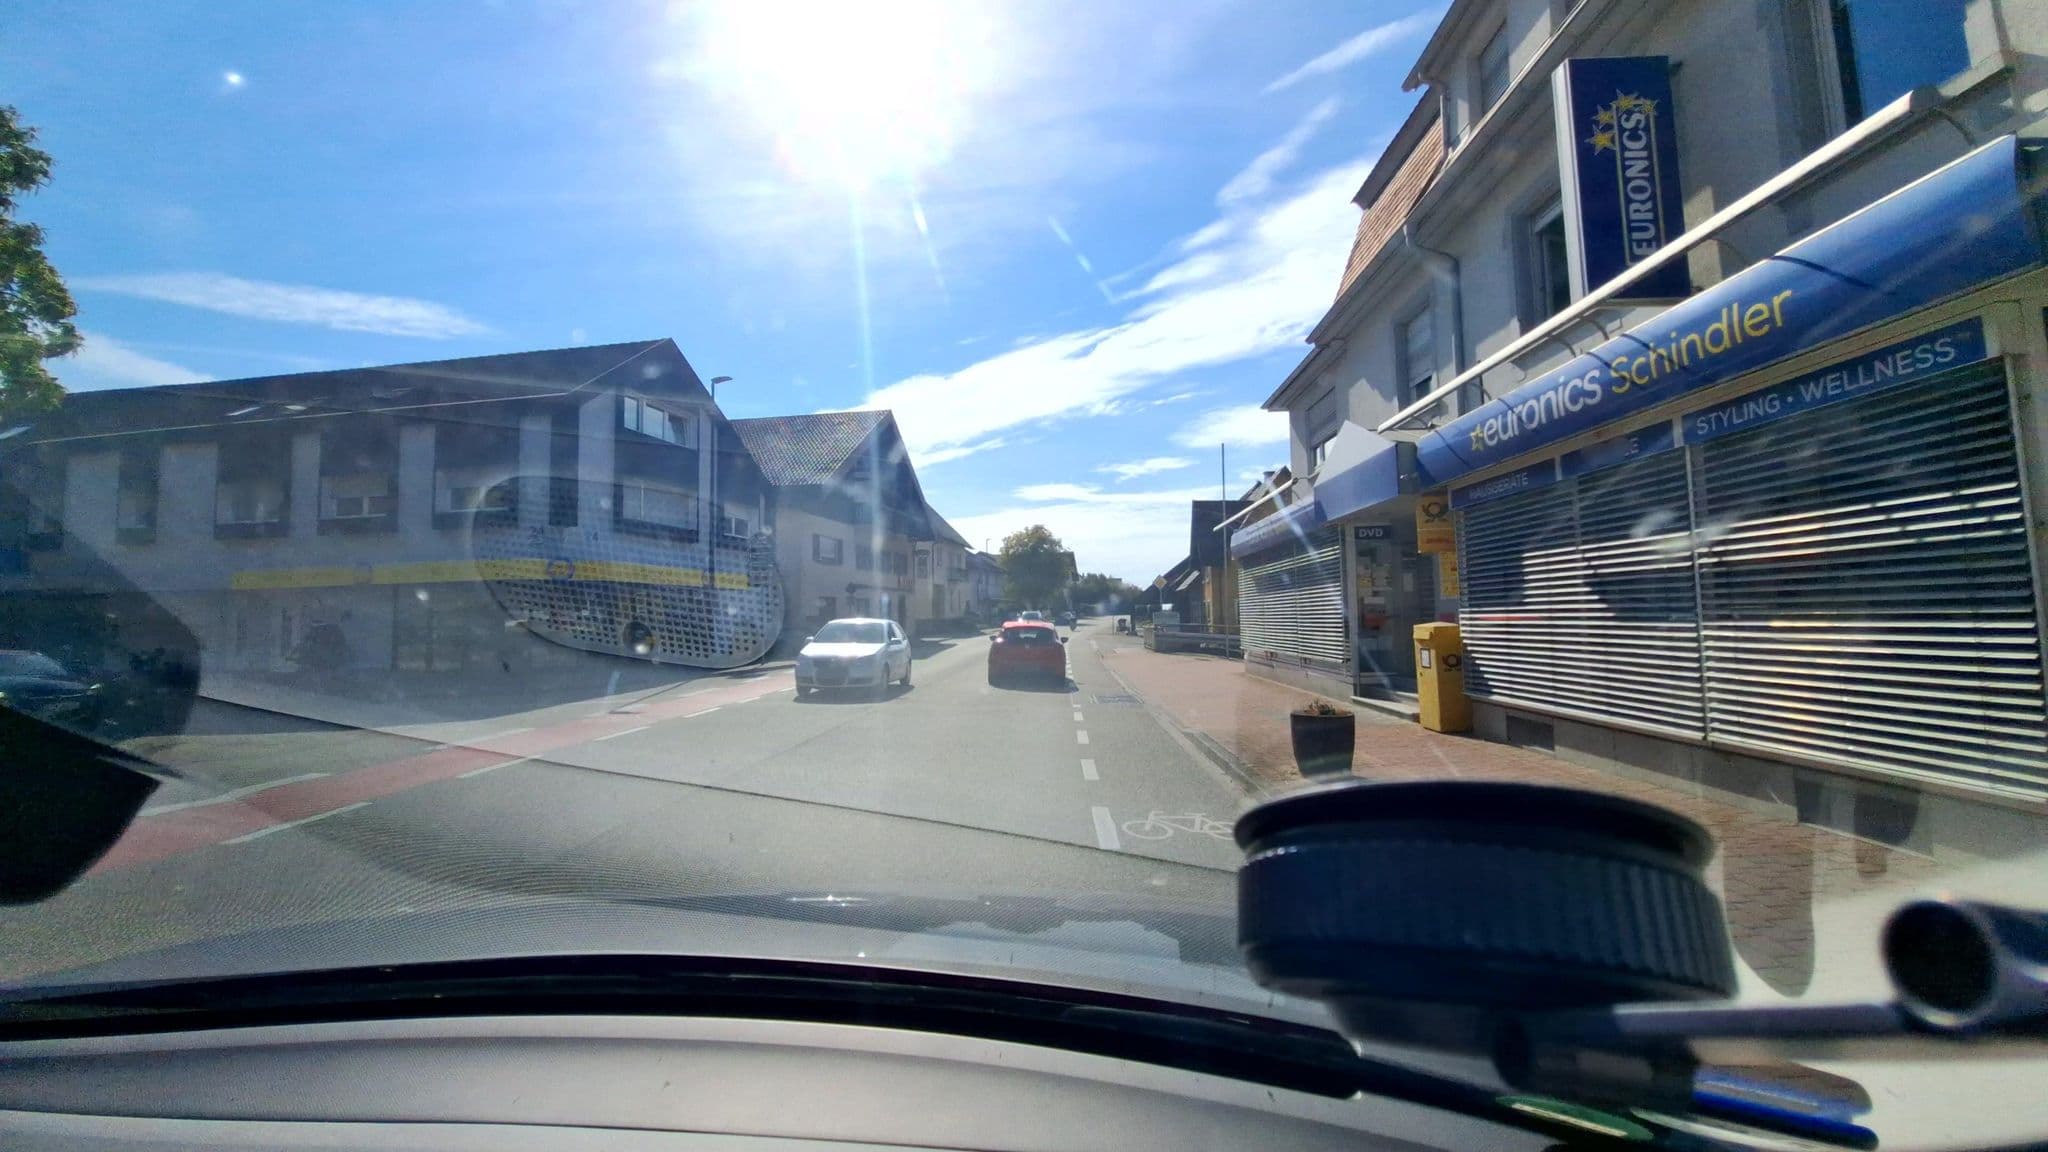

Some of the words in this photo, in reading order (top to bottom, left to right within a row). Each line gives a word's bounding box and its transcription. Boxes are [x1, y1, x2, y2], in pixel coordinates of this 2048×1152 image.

[1621, 112, 1658, 256] EURONICS
[1483, 366, 1603, 447] euronics
[1611, 289, 1792, 394] Schindler
[1696, 394, 1781, 435] STYLING
[1800, 337, 1956, 403] WELLNESS
[1359, 527, 1384, 538] DVD
